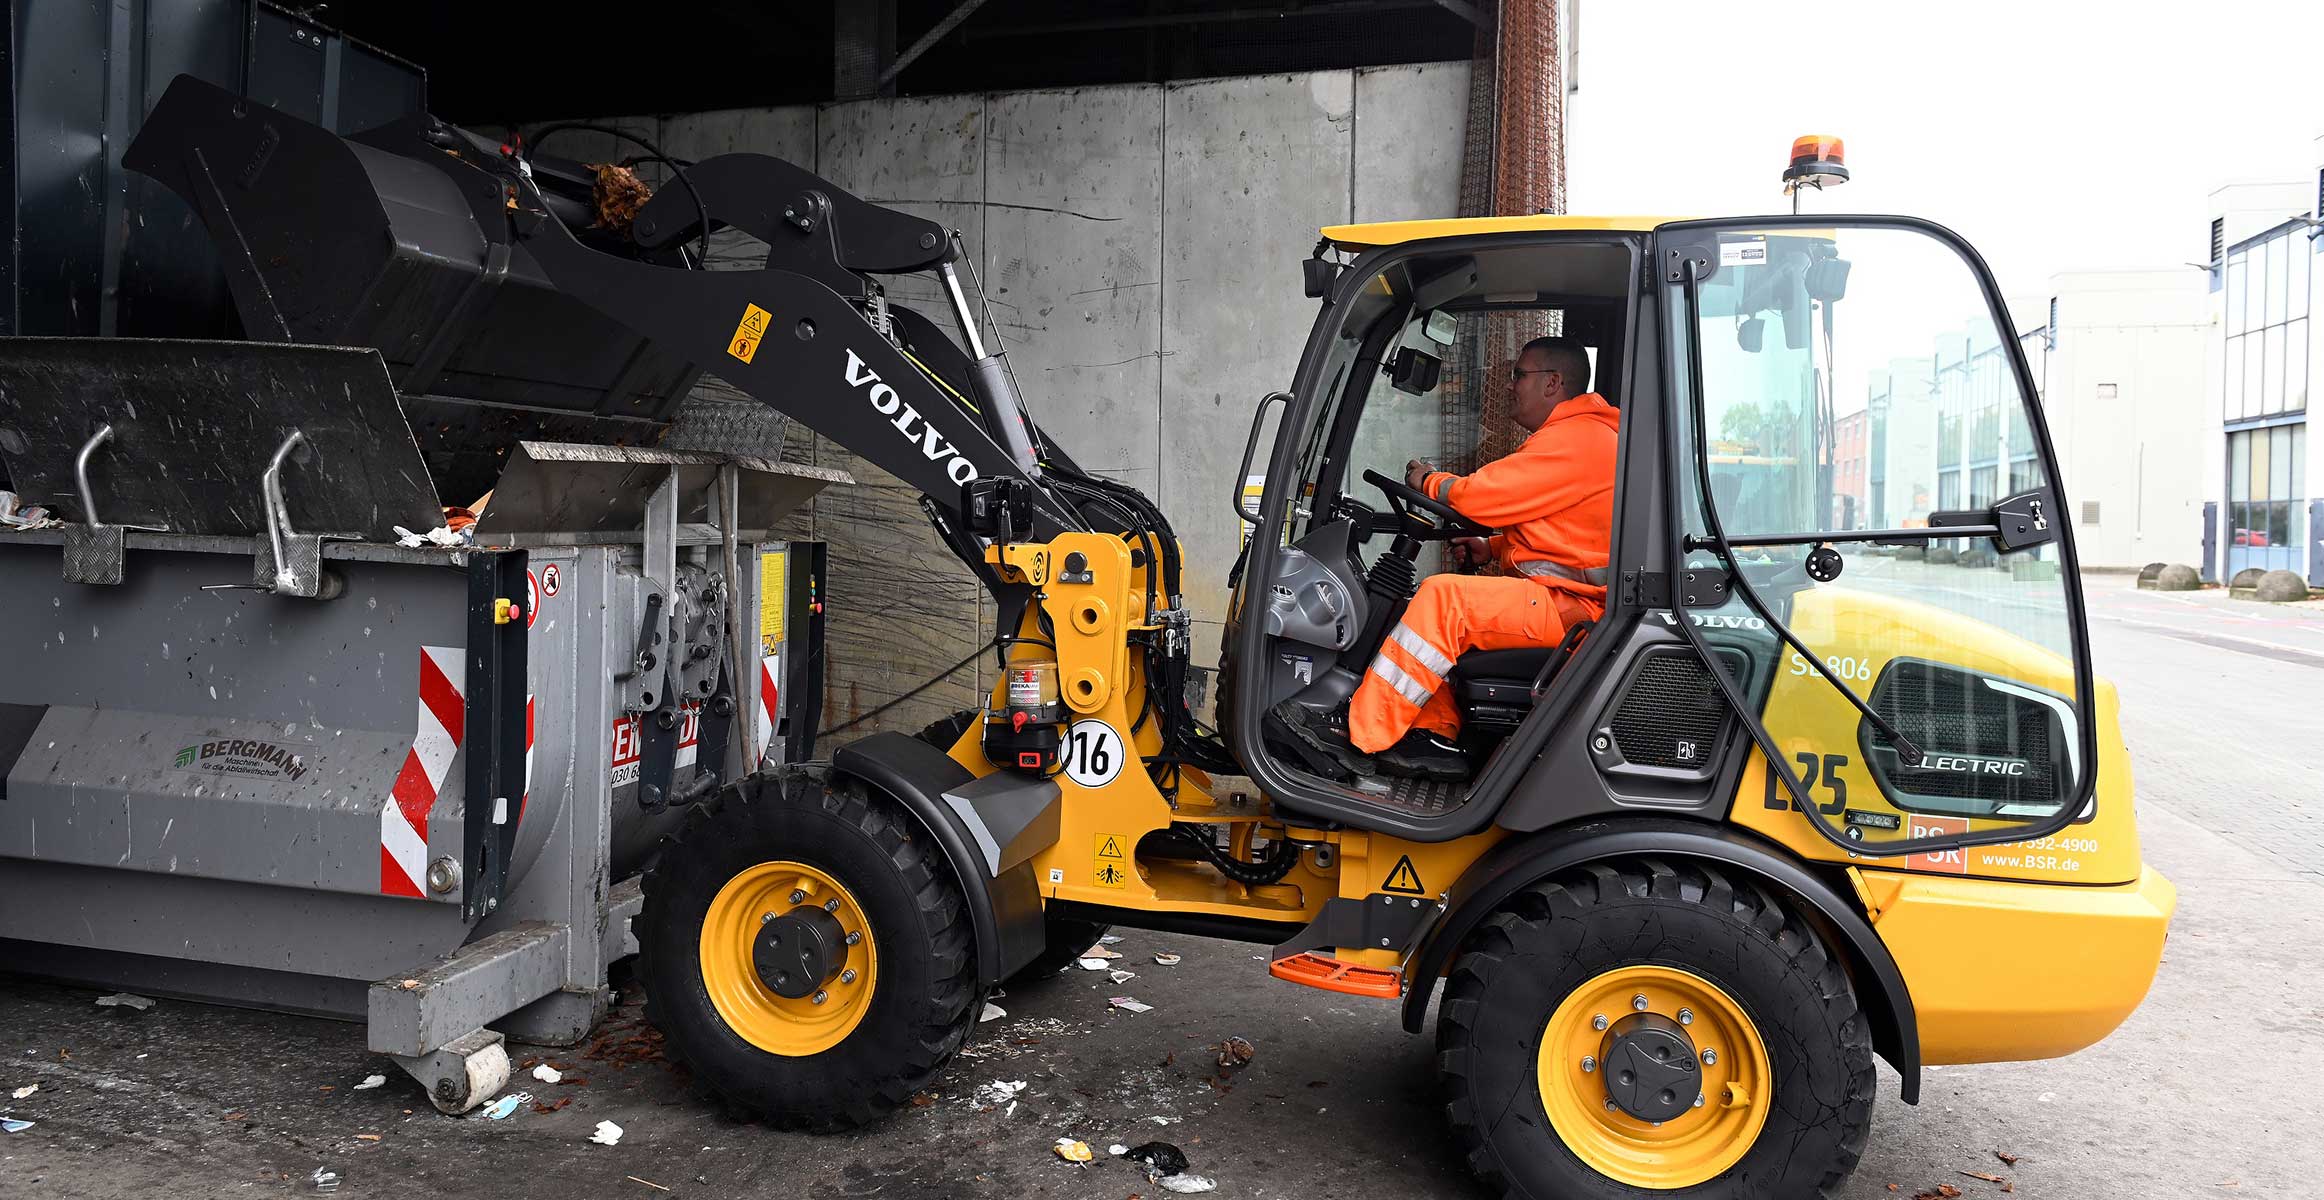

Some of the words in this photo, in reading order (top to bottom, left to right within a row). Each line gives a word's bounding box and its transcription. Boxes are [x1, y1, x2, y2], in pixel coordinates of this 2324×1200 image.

[845, 348, 978, 487] VOLVO
[200, 740, 308, 782] BERGMANN
[224, 757, 264, 768] Maschinen
[1074, 731, 1109, 776] 16
[1905, 756, 2025, 776] LECTRIC
[1764, 752, 1849, 816] L25
[1982, 854, 2080, 871] www.BSR.de
